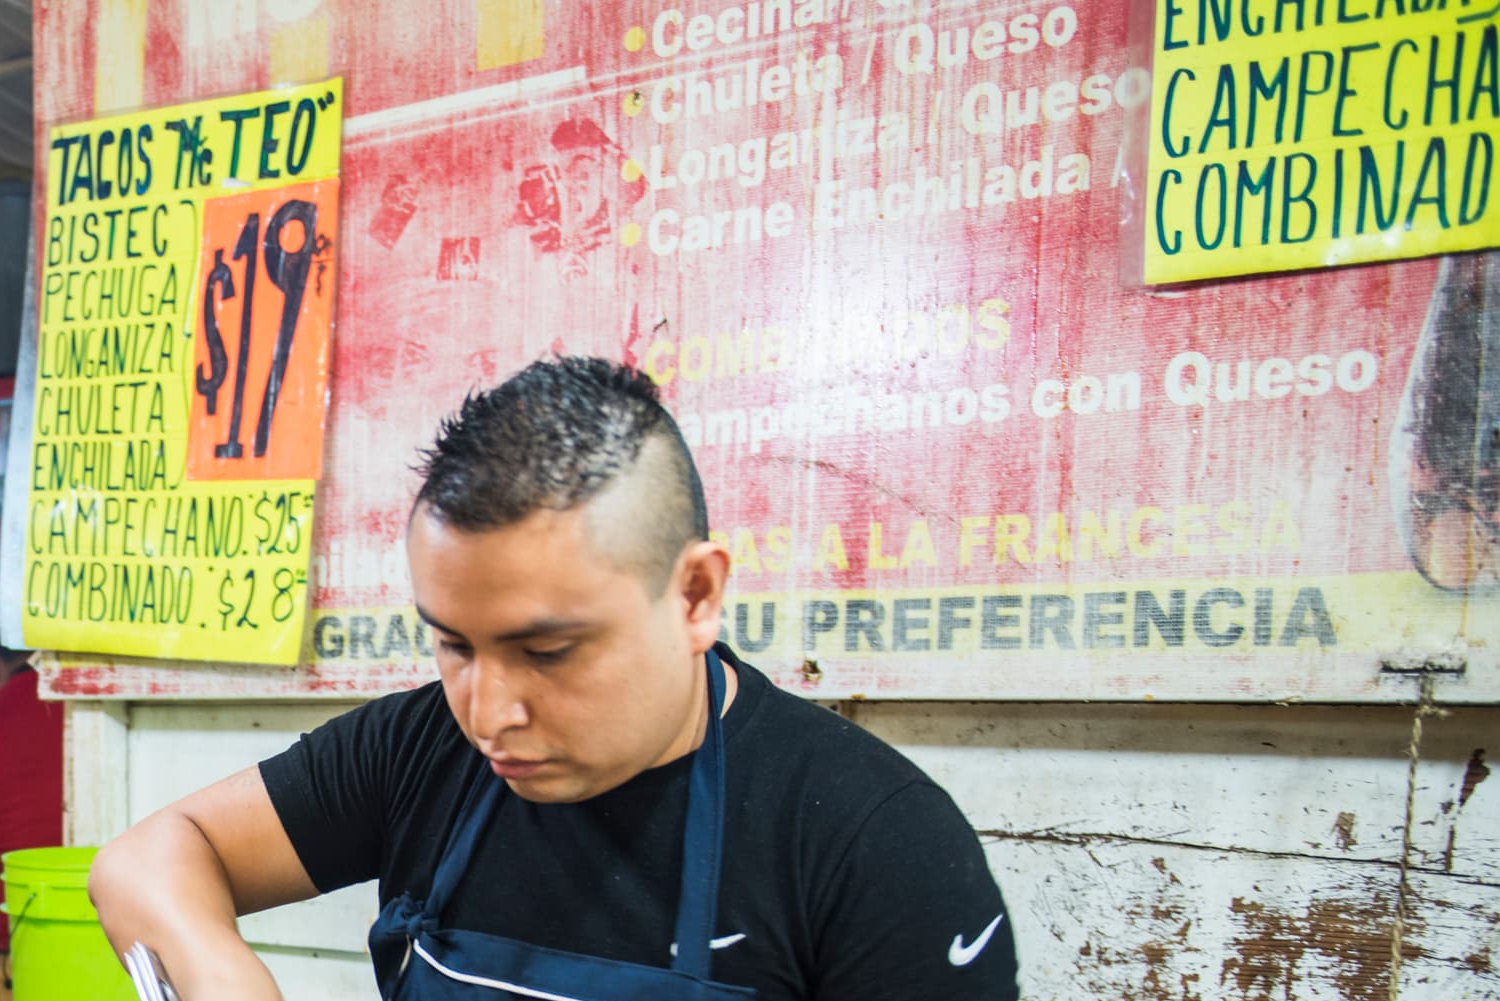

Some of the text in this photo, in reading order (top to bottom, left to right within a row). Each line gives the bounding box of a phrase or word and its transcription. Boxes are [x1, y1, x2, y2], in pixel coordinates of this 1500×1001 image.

[650, 46, 844, 124] Chuleta
[894, 6, 1078, 75] Queso
[1161, 24, 1500, 158] CAMPECHA
[962, 67, 1151, 137] Queso
[52, 124, 153, 205] TACOS
[1155, 132, 1494, 255] COMBINAD
[49, 204, 169, 267] BISTEC
[648, 201, 796, 257] Carne
[818, 145, 1091, 229] Enchilada
[43, 264, 178, 324] PECHUGA
[41, 322, 174, 380] LONGANIZA
[647, 299, 1011, 386] COMBDOS
[38, 381, 165, 435] CHULETA
[678, 349, 1379, 453] ampechanos con Queso
[33, 440, 167, 492] ENCHILADA
[813, 523, 849, 572] A
[868, 519, 938, 570] LA
[959, 502, 1302, 567] FRANCESA
[802, 586, 1338, 652] PREFERENCIA
